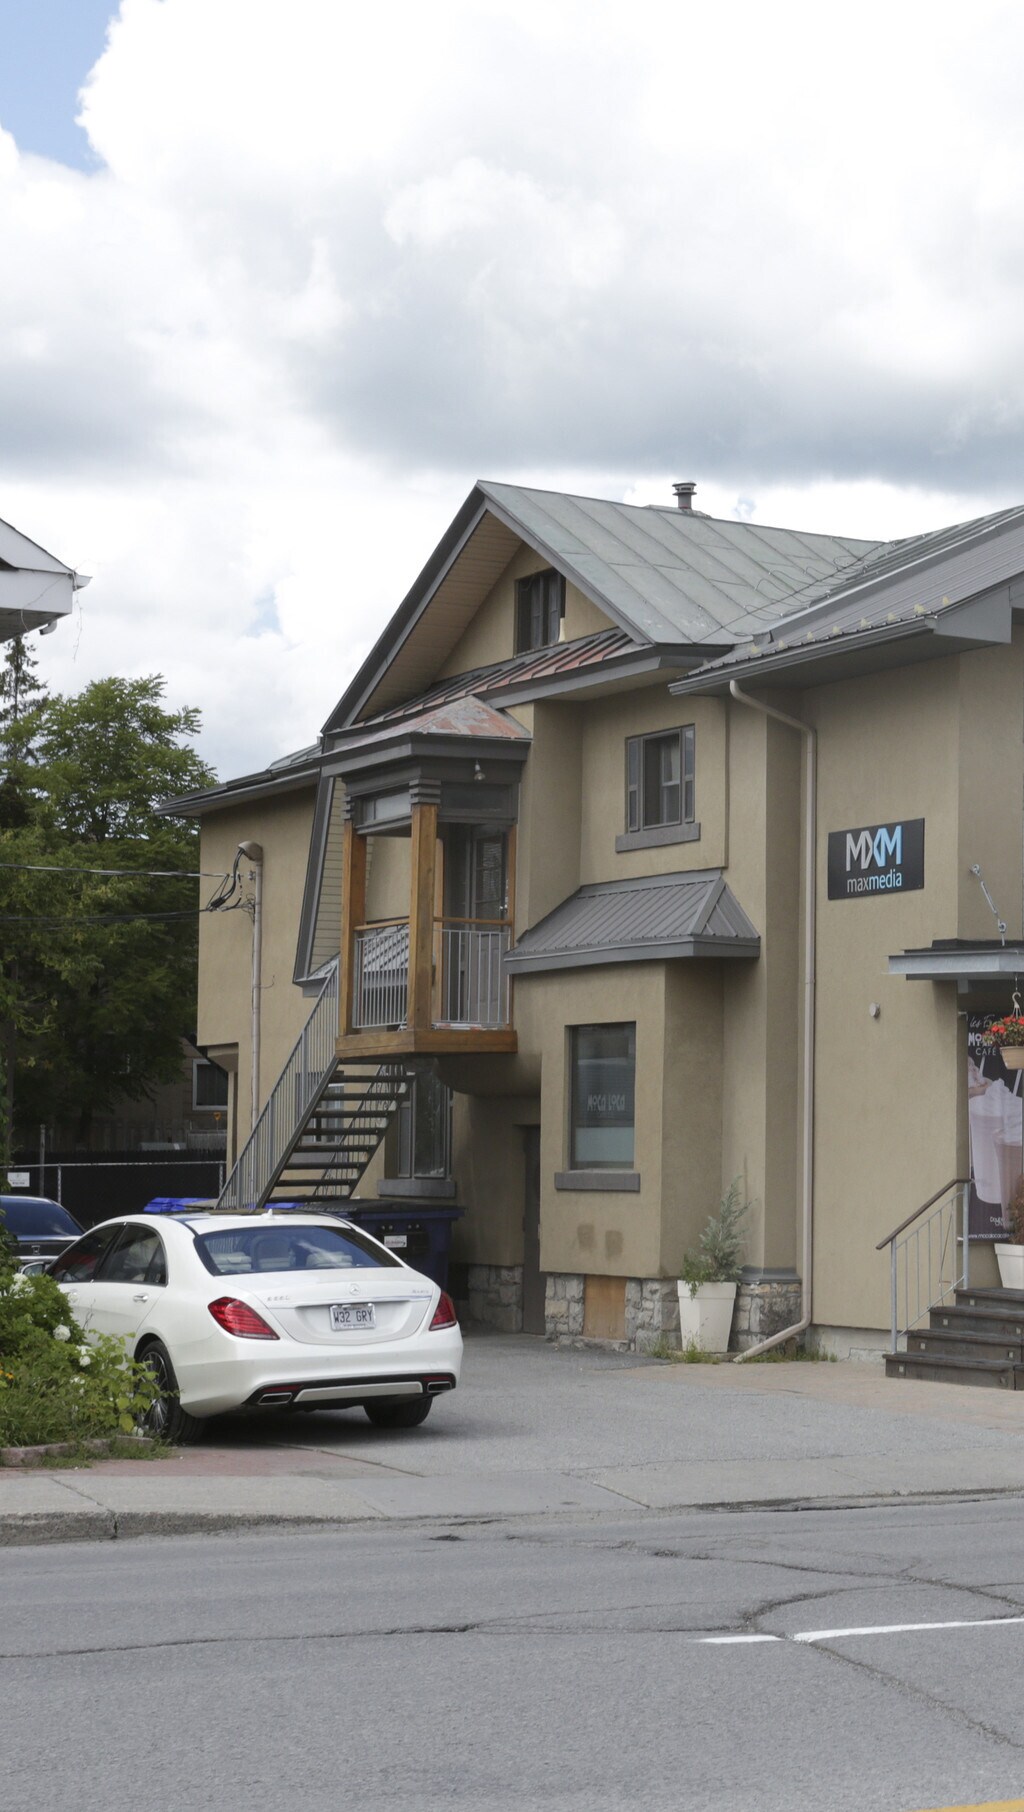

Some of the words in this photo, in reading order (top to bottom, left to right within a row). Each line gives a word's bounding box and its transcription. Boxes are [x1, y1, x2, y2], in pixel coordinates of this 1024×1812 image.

[845, 825, 902, 872] MXM
[846, 868, 903, 893] maxmedia
[333, 1310, 351, 1323] W32
[355, 1309, 373, 1322] GRY
